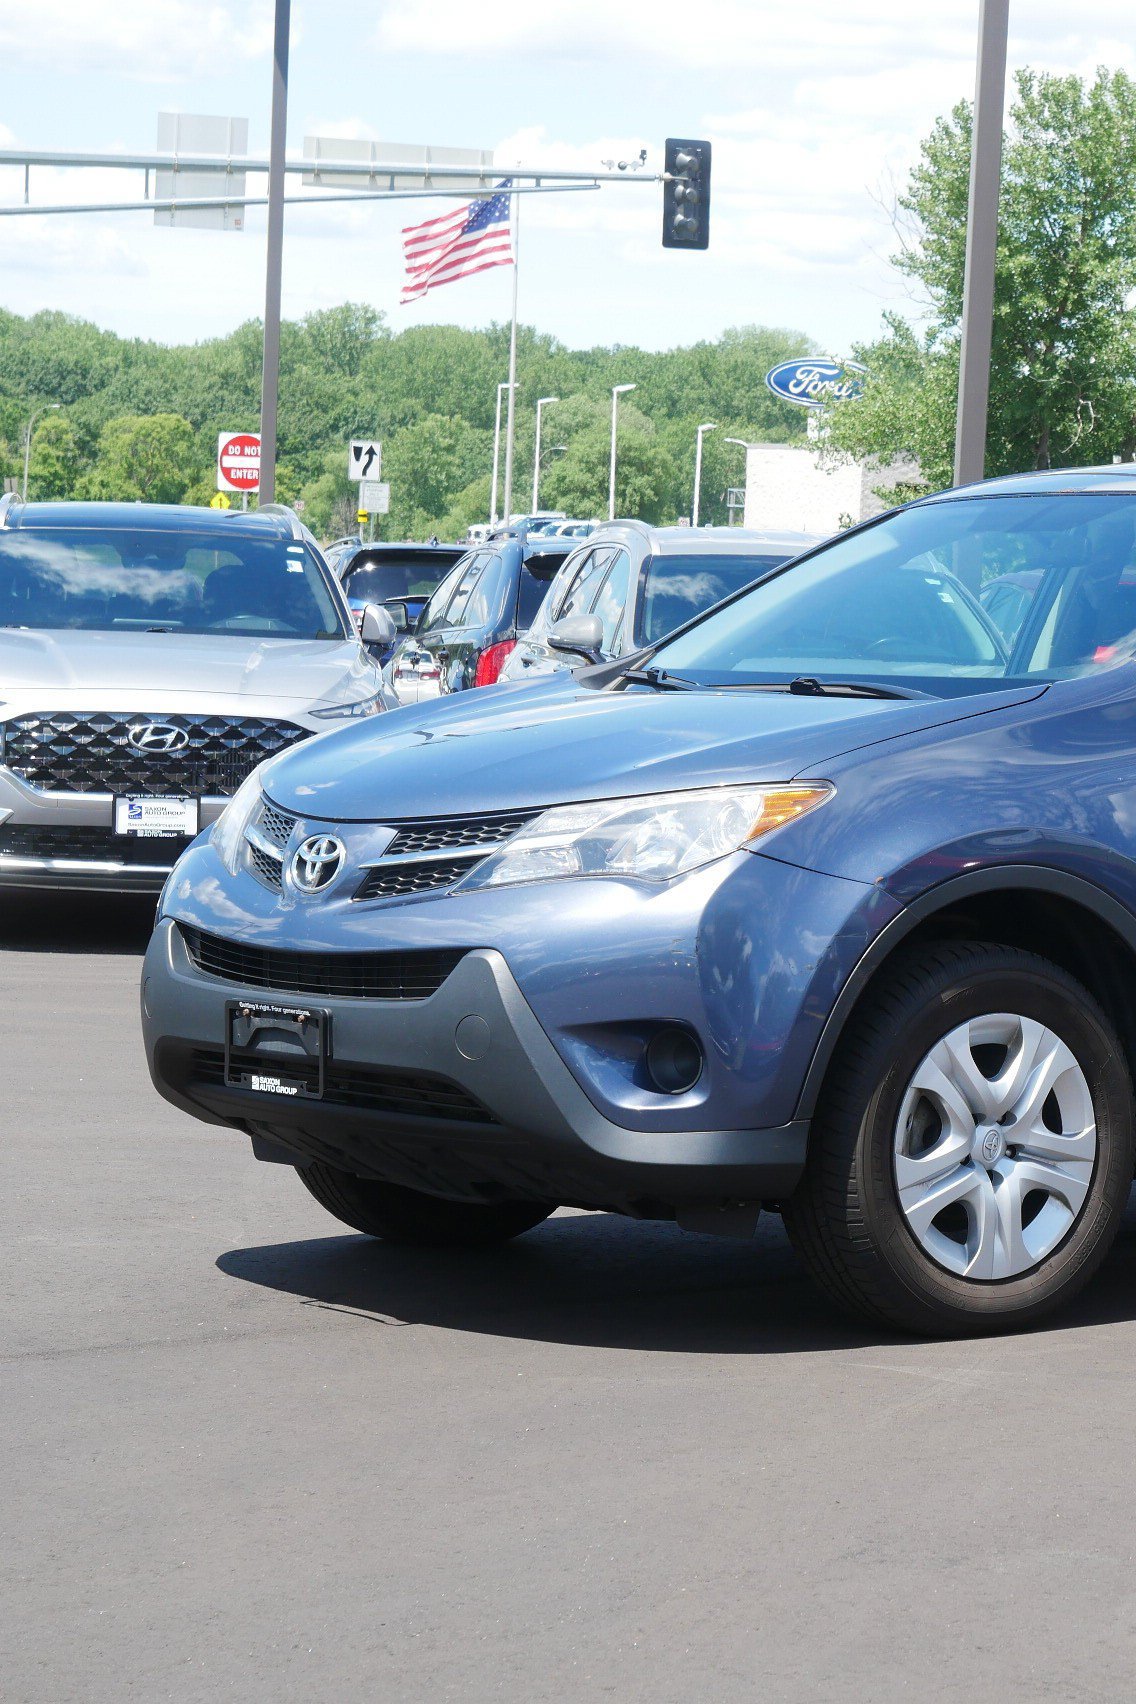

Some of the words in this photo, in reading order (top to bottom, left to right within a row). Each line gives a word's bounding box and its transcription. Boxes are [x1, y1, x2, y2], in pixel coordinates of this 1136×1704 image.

[789, 366, 853, 398] Ford
[228, 445, 241, 455] DO
[244, 445, 261, 456] NOT
[230, 469, 259, 480] ENTER
[239, 1001, 256, 1011] Getting
[260, 1076, 280, 1085] SAXON
[260, 1084, 275, 1093] AUTO
[275, 1087, 298, 1095] GROUP
